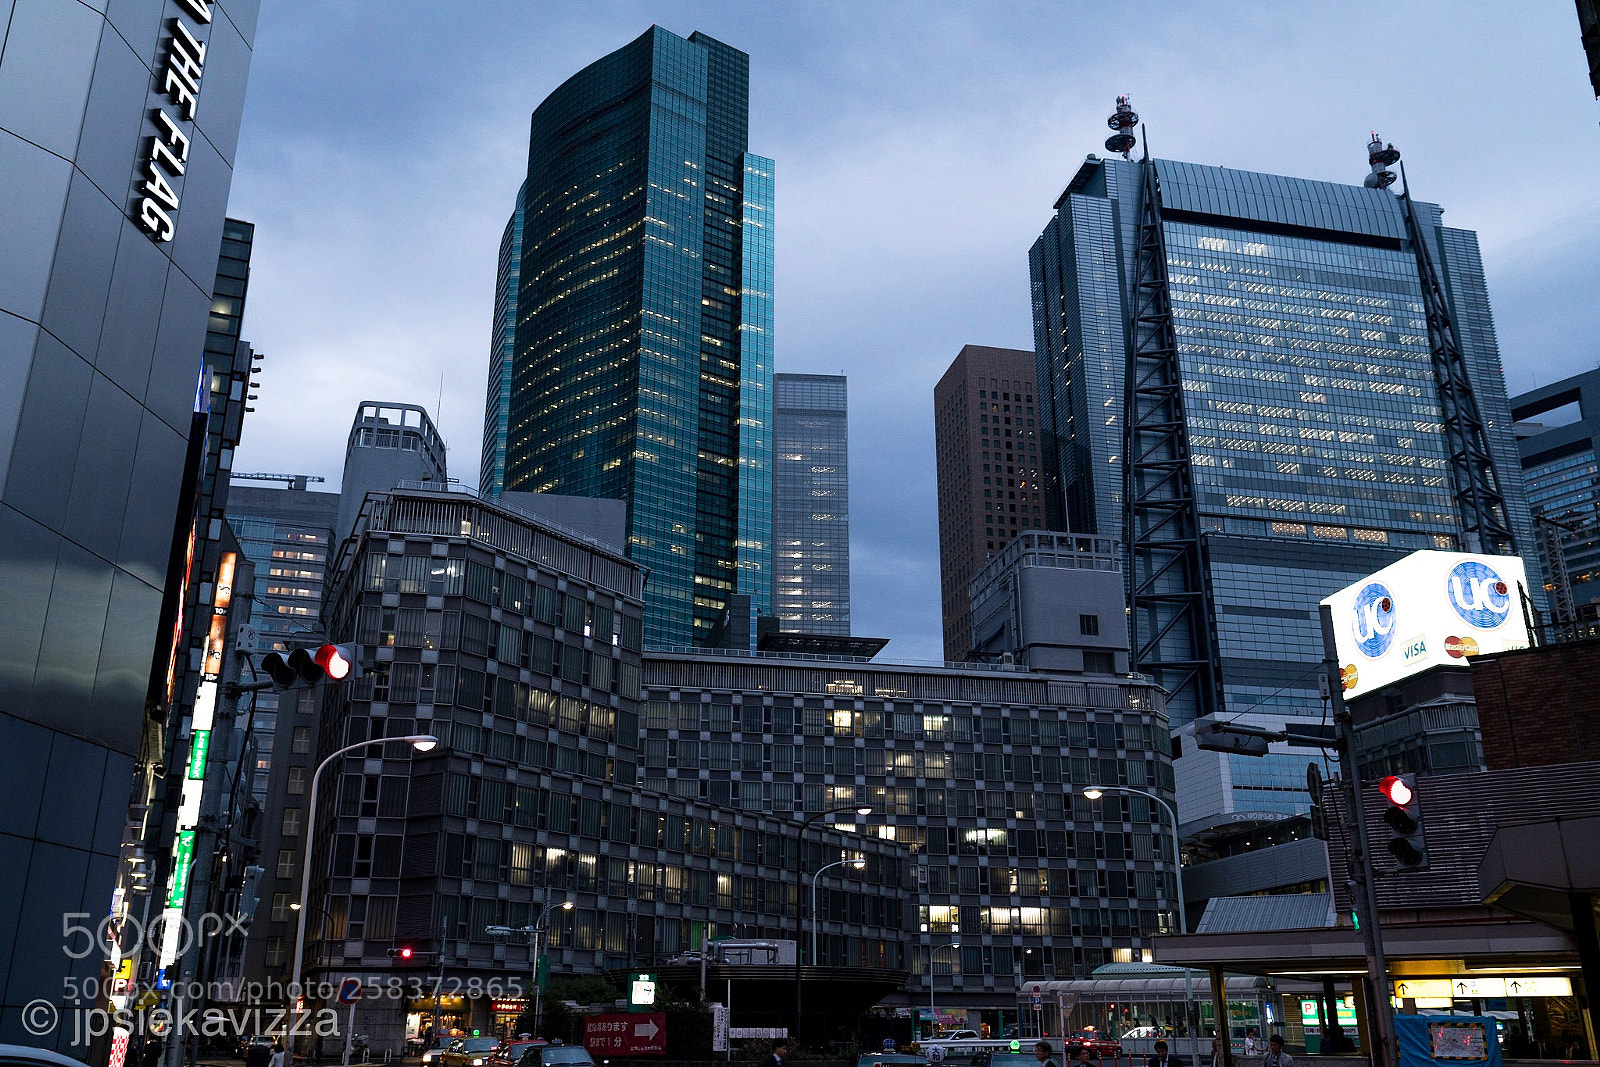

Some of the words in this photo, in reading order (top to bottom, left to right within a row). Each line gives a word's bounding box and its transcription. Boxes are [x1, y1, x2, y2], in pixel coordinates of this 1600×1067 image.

[165, 19, 206, 119] THE
[141, 109, 190, 242] FLAG
[1404, 640, 1427, 660] VISA
[1445, 643, 1479, 652] MasterCard
[1304, 1003, 1312, 1013] P
